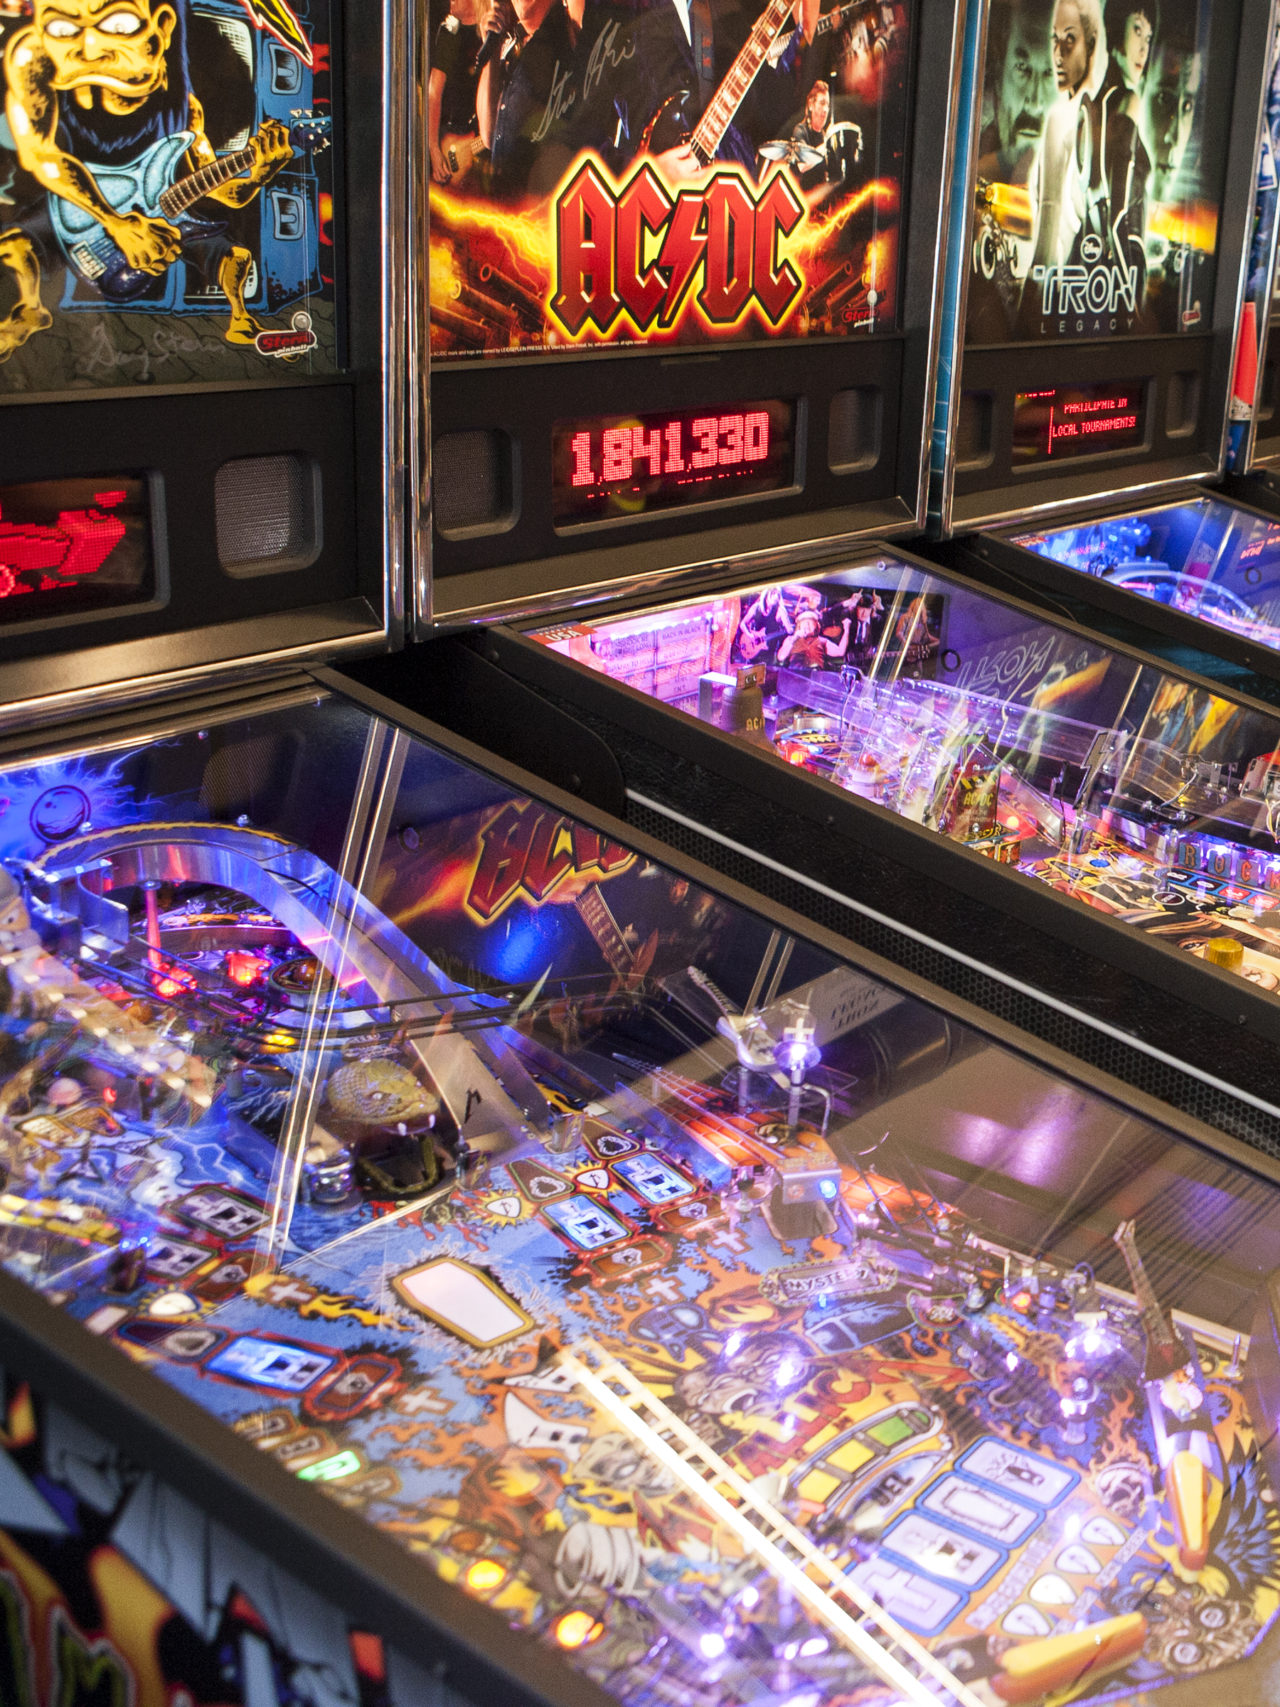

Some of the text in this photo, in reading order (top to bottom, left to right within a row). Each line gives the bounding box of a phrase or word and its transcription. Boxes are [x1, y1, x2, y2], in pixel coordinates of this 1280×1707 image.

[552, 159, 805, 337] AC/DC
[1033, 265, 1138, 314] TRON
[1041, 319, 1133, 333] LEGACY
[262, 334, 311, 350] Stern
[1052, 416, 1137, 438] LOCAL TOURNAMENTS!
[571, 412, 769, 486] 1,841,330
[546, 630, 584, 641] USA
[963, 791, 994, 808] AC/DC
[785, 1267, 870, 1292] MYSTEY
